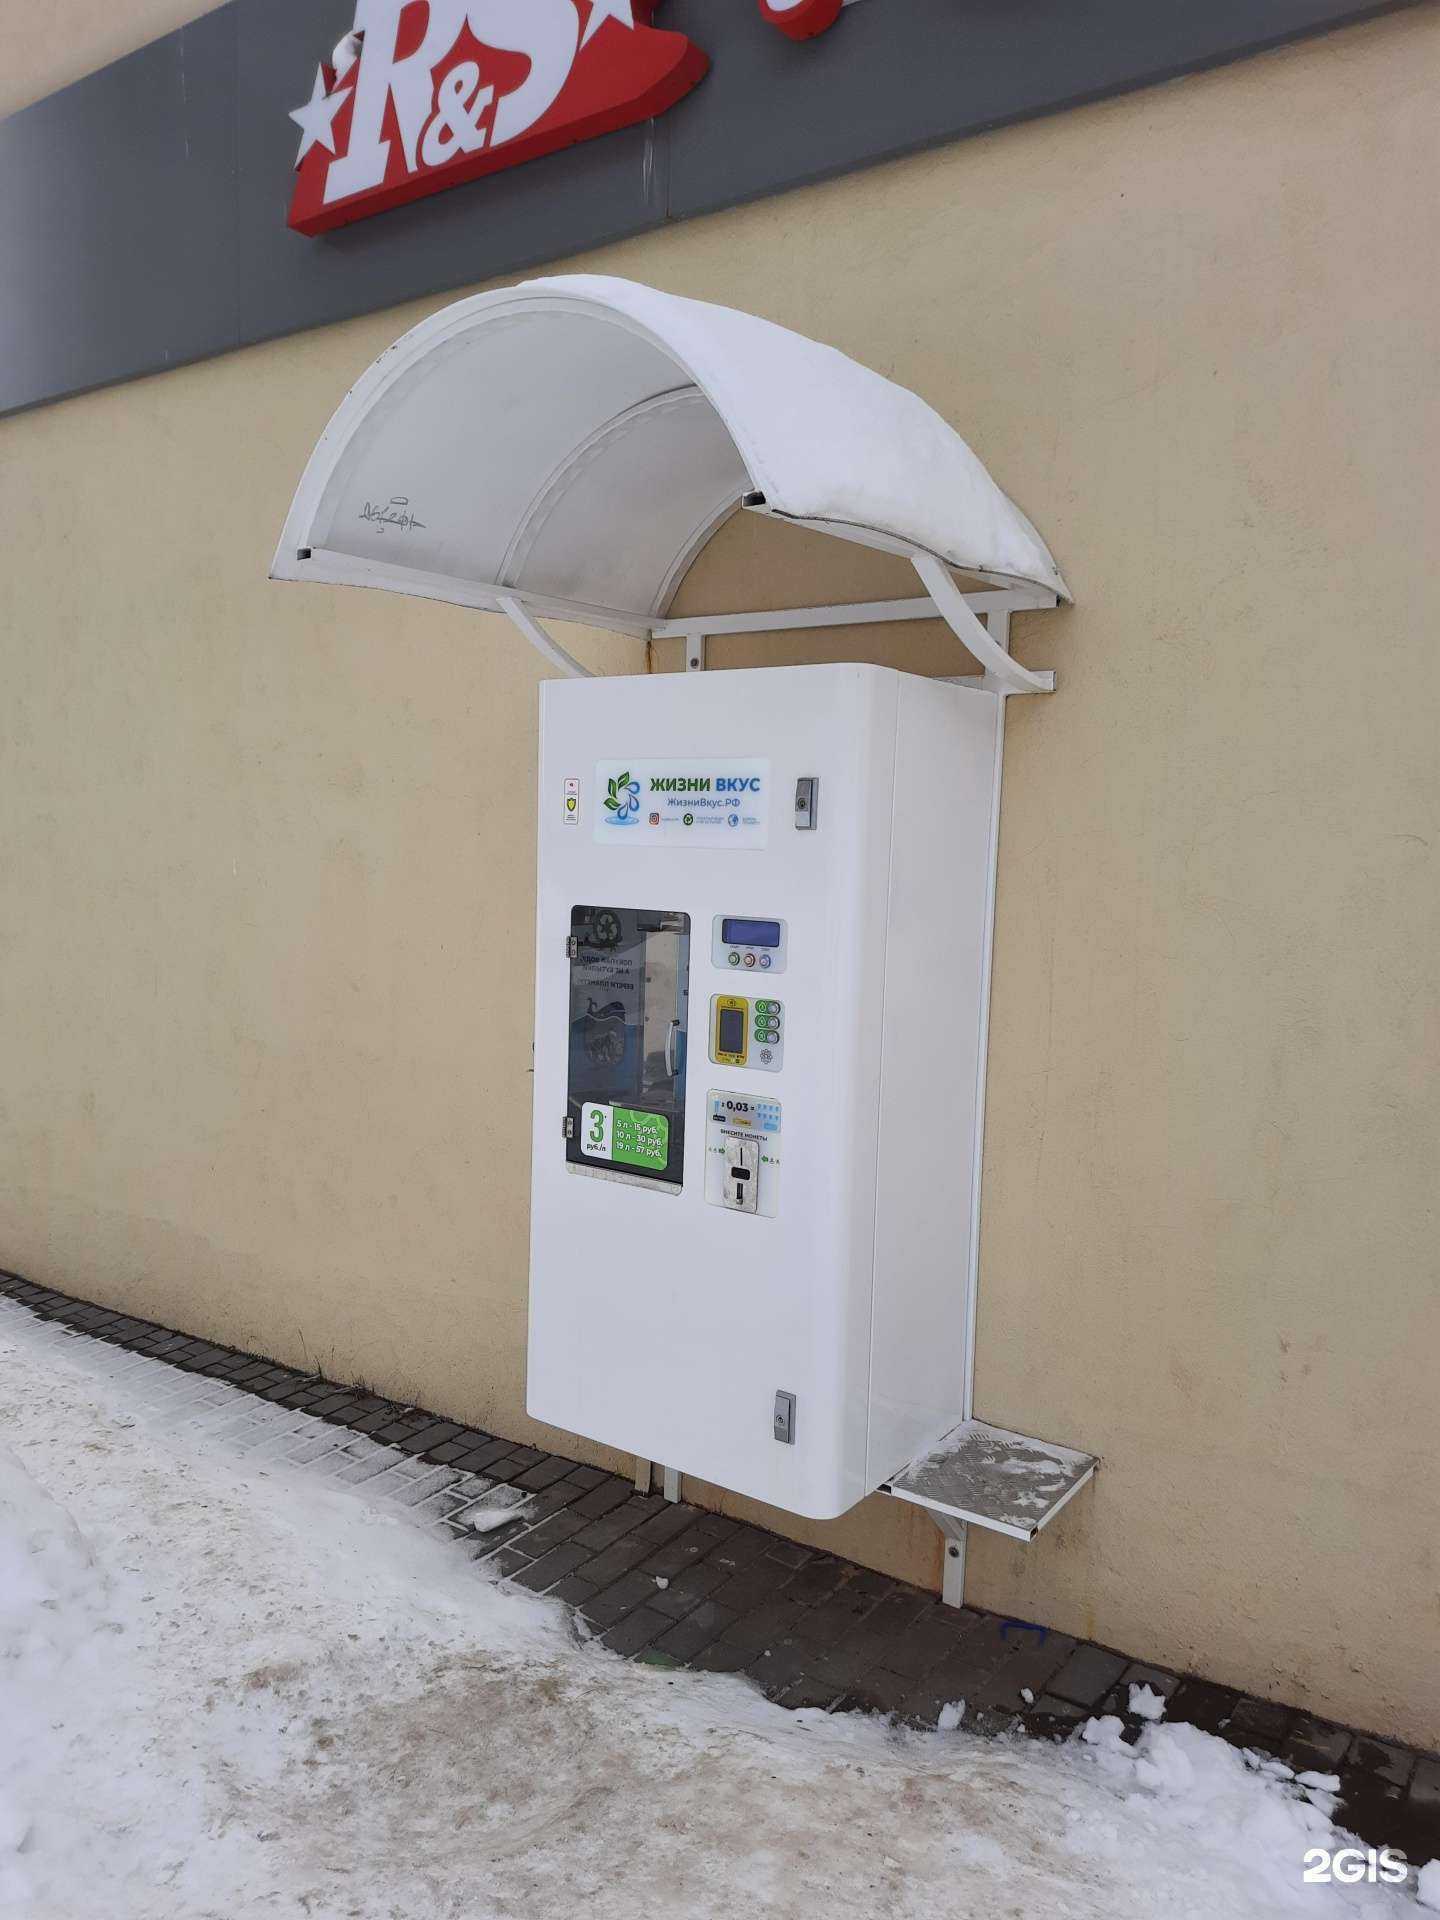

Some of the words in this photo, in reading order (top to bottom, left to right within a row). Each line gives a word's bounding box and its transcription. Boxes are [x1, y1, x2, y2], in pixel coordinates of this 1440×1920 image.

[650, 778, 711, 792] ЖИЗНИ
[715, 777, 761, 793] ВКУС
[667, 797, 741, 809] ЖизниВкус.РФ
[726, 1101, 748, 1112] 0,03
[589, 1110, 604, 1142] 3
[616, 1141, 624, 1149] 19
